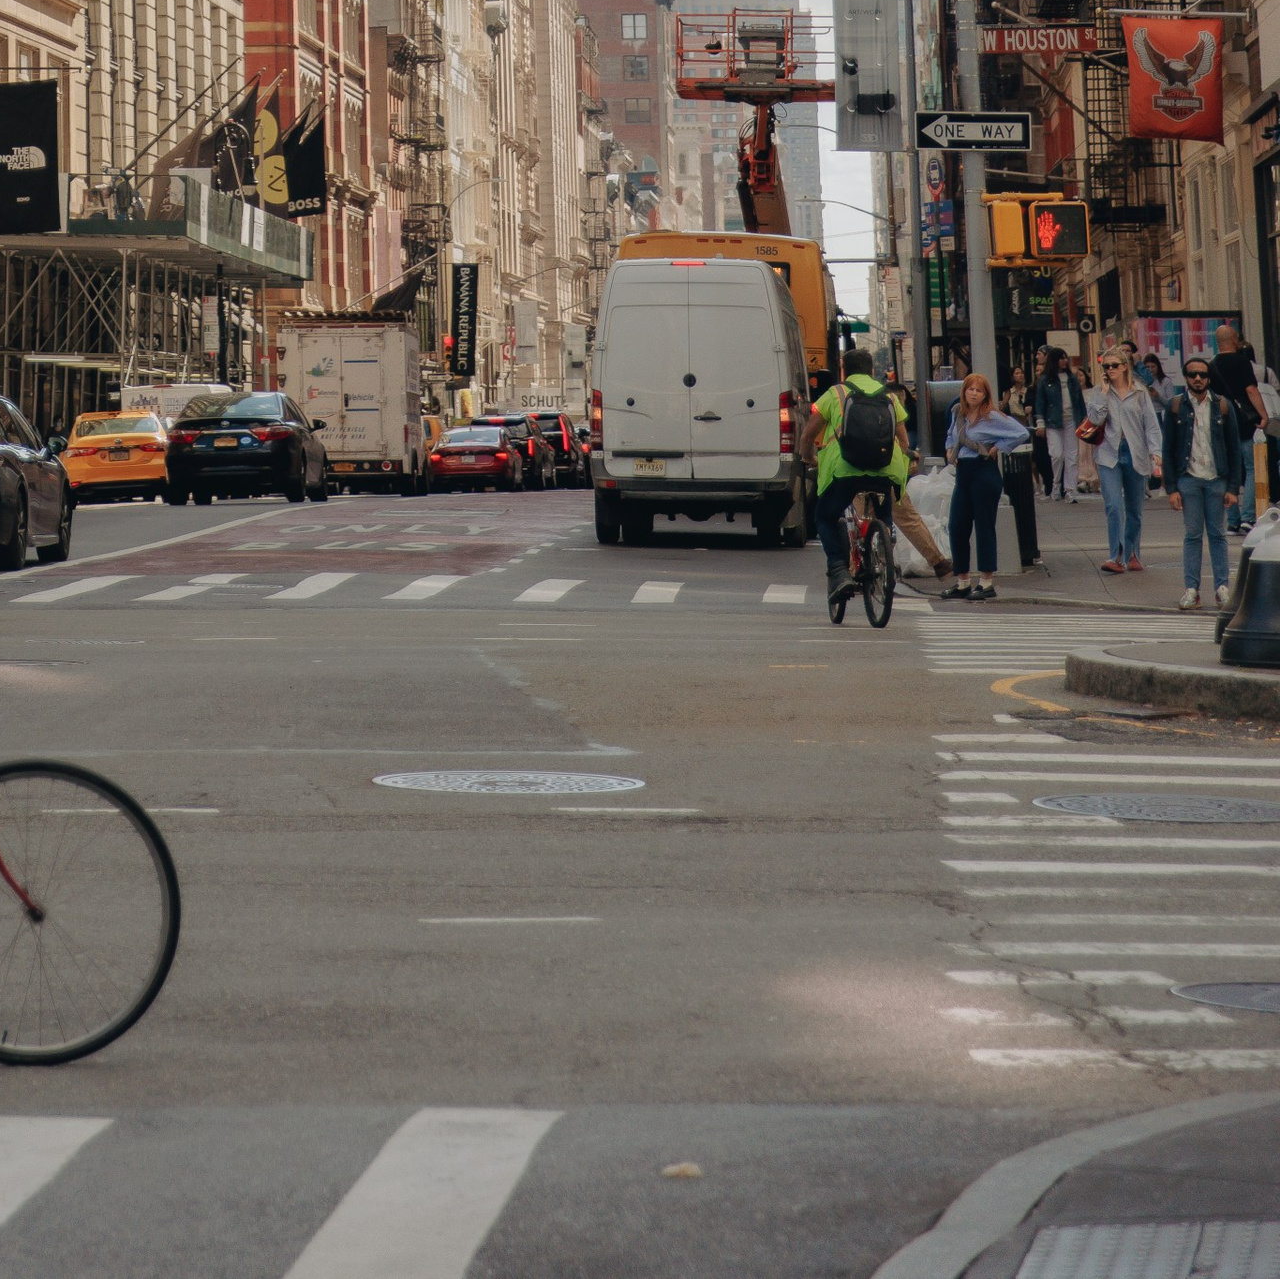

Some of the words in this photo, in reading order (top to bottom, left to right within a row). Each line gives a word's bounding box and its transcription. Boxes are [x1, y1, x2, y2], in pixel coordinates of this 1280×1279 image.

[983, 30, 997, 51] W
[1004, 29, 1079, 51] HOUSTON
[934, 124, 965, 138] ONE
[981, 125, 1015, 138] WAY
[11, 147, 30, 155] THE
[7, 162, 30, 170] FACE
[288, 197, 321, 212] BOSS
[755, 246, 779, 256] 1585
[459, 267, 471, 314] BANANA
[457, 314, 470, 370] REPUBLIC
[279, 524, 502, 535] ONLY
[227, 541, 448, 550] BUS
